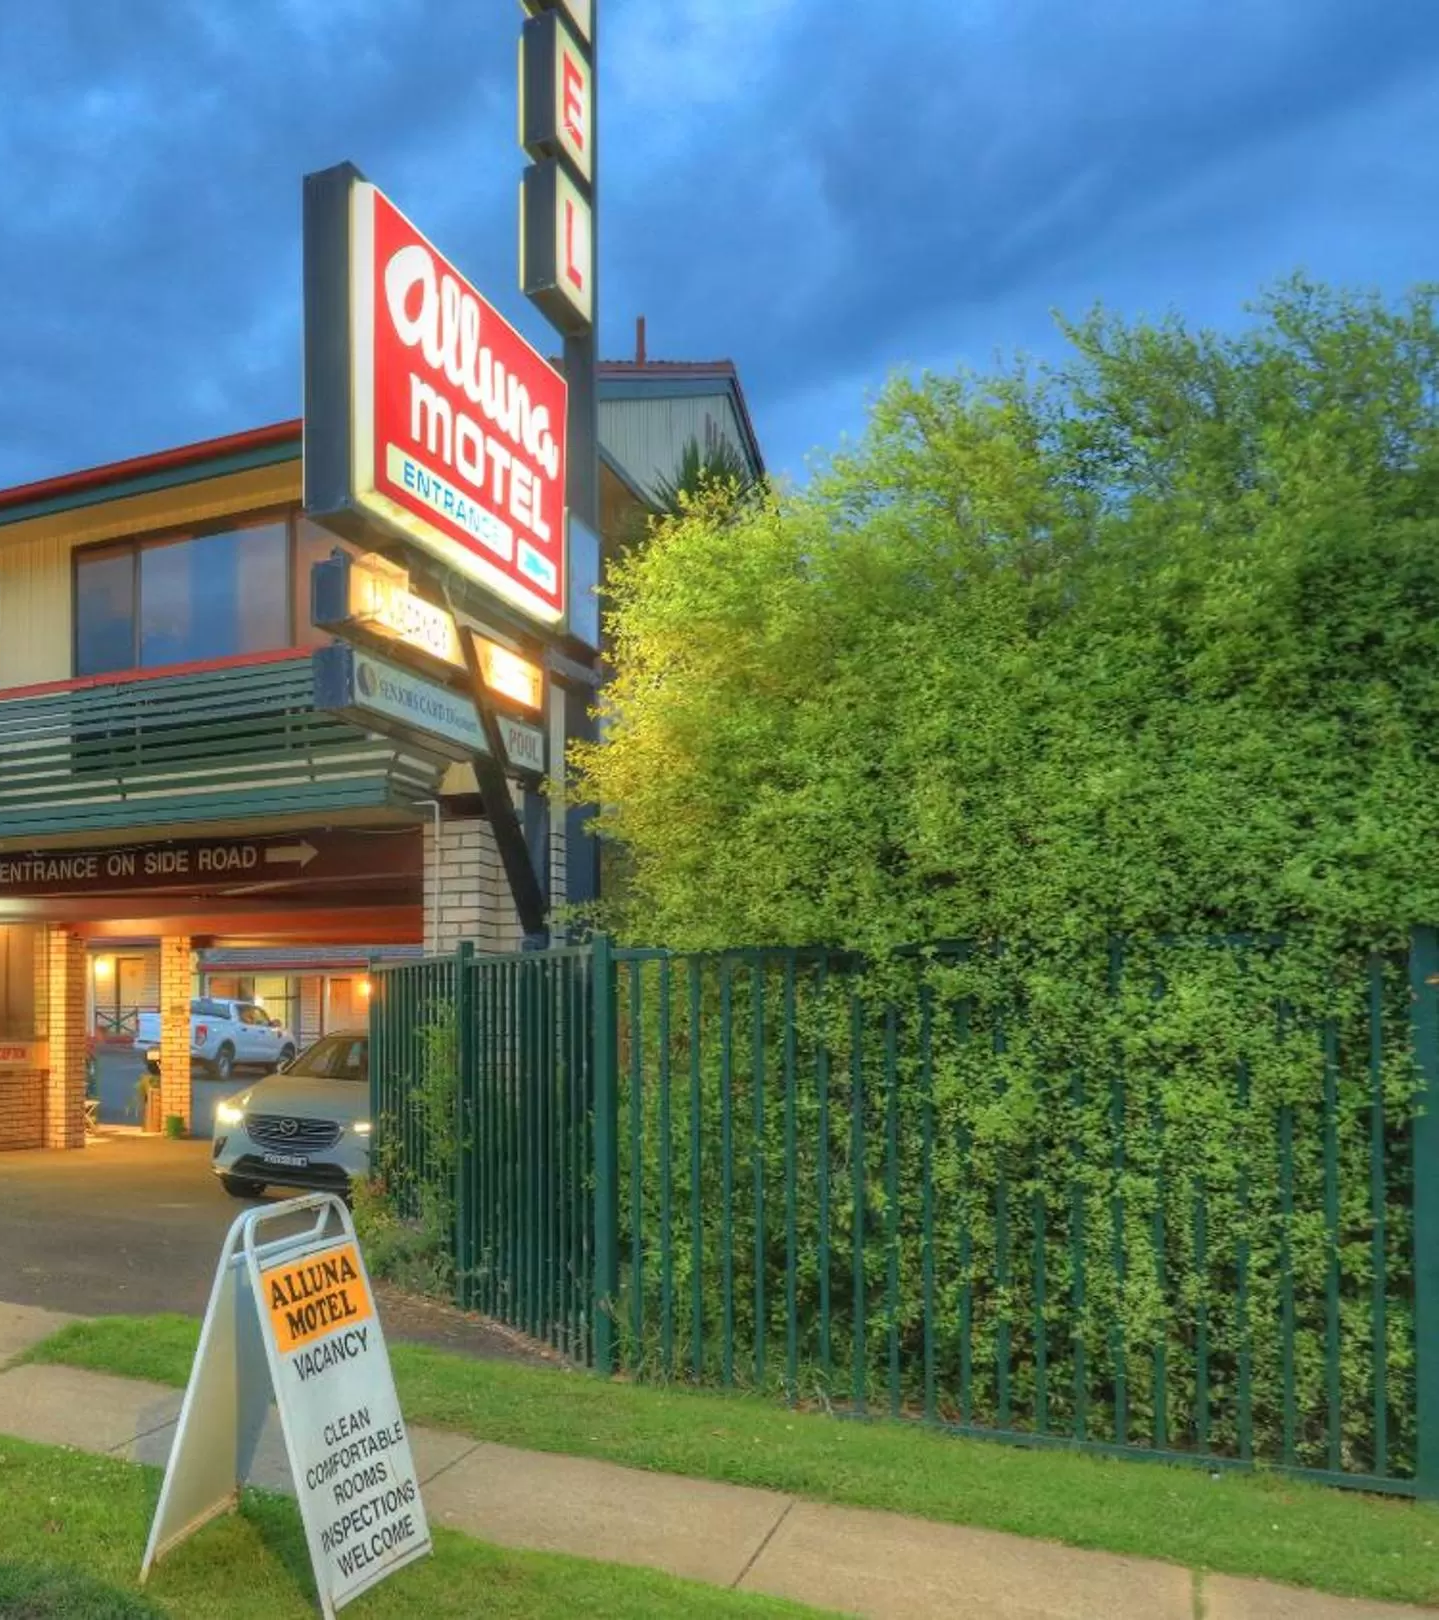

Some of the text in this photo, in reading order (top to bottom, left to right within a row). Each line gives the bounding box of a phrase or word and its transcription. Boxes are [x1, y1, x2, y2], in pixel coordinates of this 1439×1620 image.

[409, 371, 551, 543] MOTEL
[507, 727, 539, 760] POOL
[0, 856, 98, 883] ENTRANCE
[108, 854, 135, 876] ON
[144, 851, 188, 874] SIDE
[198, 846, 257, 871] ROAD
[271, 1255, 358, 1310] ALLUNA
[285, 1289, 358, 1341] MOTEL
[292, 1326, 367, 1381] VACANCY
[323, 1406, 371, 1447] CLEAN
[306, 1420, 404, 1490] COMFORTABLE
[333, 1461, 387, 1505] ROOMS
[321, 1478, 415, 1556] INSPECTIONS
[337, 1514, 416, 1579] WELCOME
